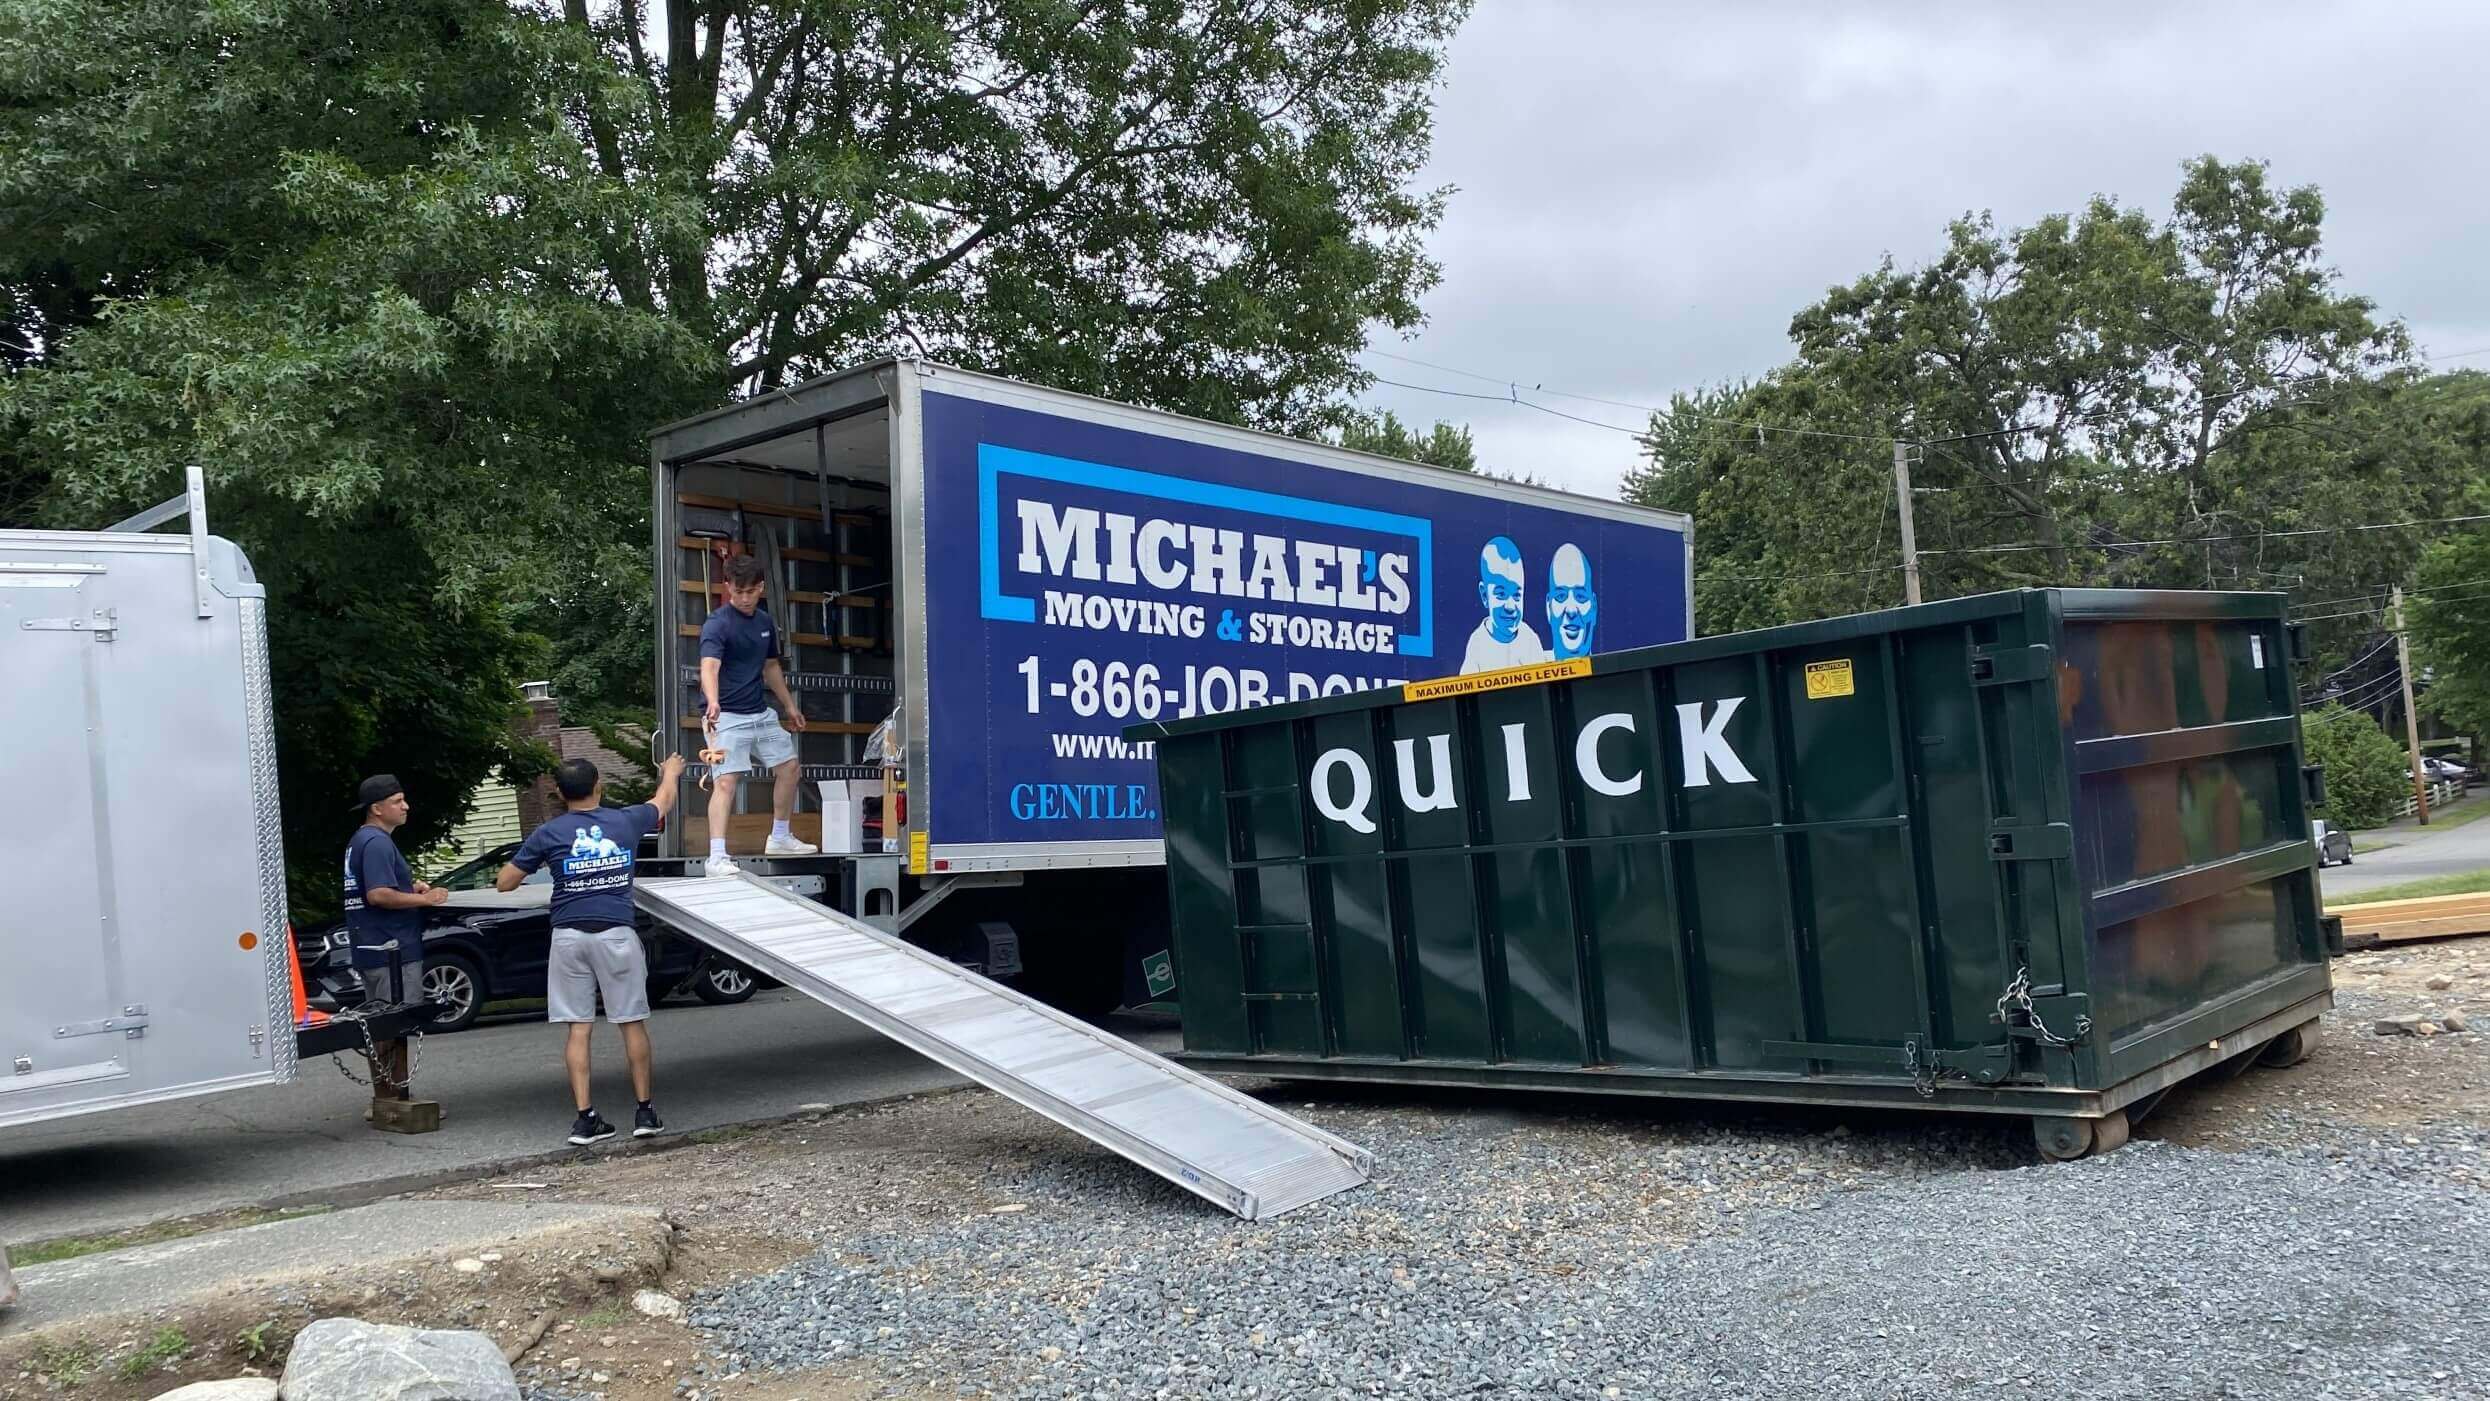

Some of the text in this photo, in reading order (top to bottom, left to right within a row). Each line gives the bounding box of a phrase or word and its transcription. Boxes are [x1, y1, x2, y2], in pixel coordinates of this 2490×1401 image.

[1016, 498, 1411, 614] MICHAEL'S
[1044, 590, 1394, 654] MOVING & STORAGE
[1018, 655, 1410, 720] 1-866-JOB-D
[1415, 665, 1577, 698] MAXIMUM LOADING LEVEL
[1310, 696, 1759, 834] QUICK
[1010, 783, 1156, 820] GENTLE.
